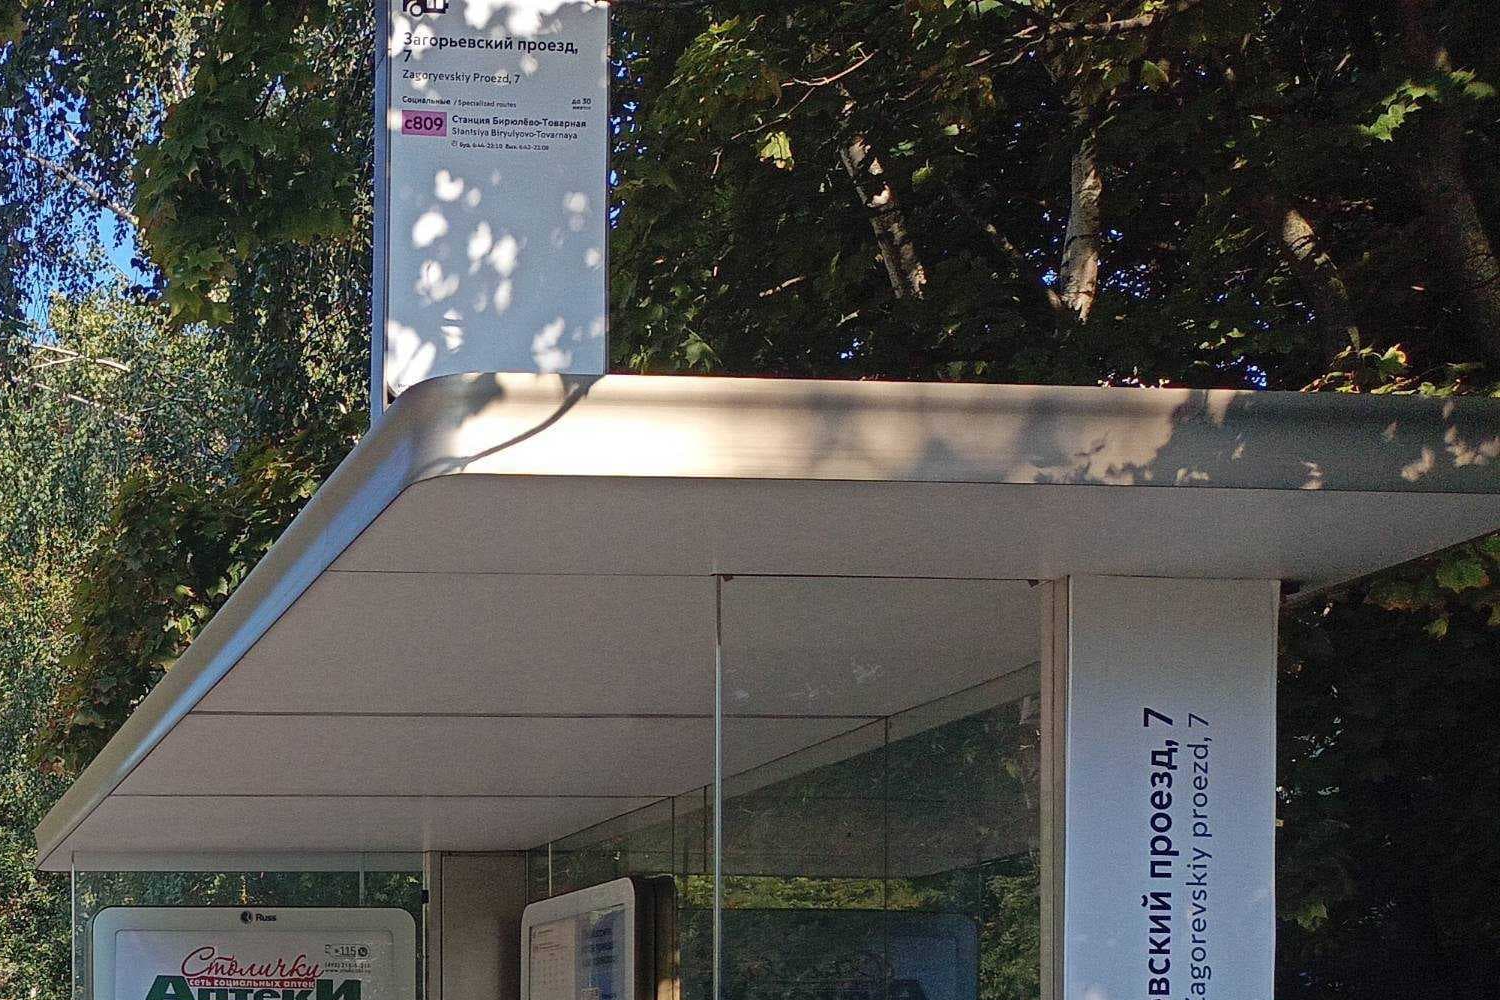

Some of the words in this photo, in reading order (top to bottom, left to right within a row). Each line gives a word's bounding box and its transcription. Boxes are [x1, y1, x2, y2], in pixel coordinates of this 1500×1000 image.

[404, 32, 513, 50] Загорьевский
[518, 39, 578, 54] проезд,
[404, 50, 412, 62] 7
[402, 69, 470, 84] Zagoryevskiy
[473, 73, 512, 84] Proezd,
[514, 74, 520, 83] 7
[405, 115, 444, 131] с809
[451, 115, 490, 126] Станция
[451, 127, 489, 138] Stantsiya
[1143, 706, 1175, 728] 7
[1188, 712, 1209, 727] 7
[1187, 736, 1213, 838] proezd,
[1149, 738, 1180, 879] проезд,
[255, 913, 277, 921] Russ
[181, 946, 324, 978] Столички
[189, 979, 212, 987] сеть
[214, 979, 280, 989] социальных
[283, 980, 315, 988] аптек
